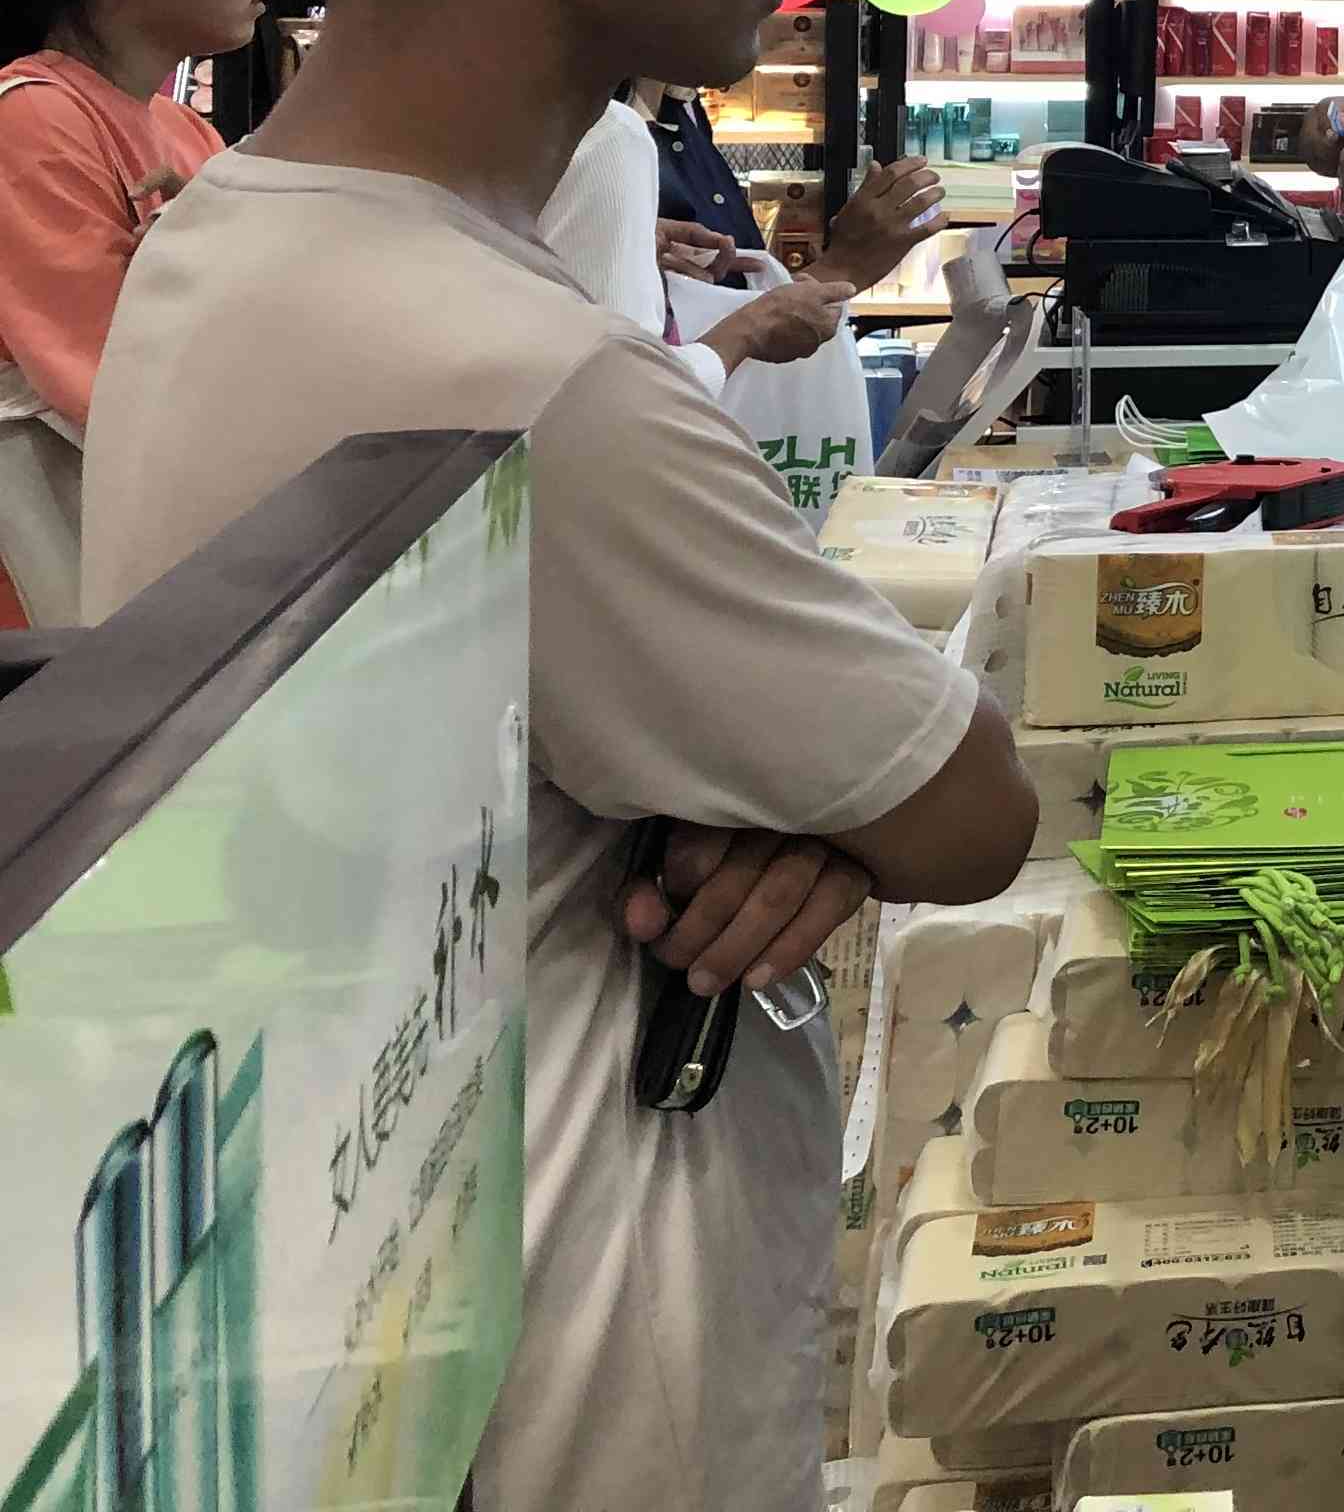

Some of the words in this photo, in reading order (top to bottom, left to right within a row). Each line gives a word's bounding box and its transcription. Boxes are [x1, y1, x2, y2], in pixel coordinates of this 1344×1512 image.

[1148, 672, 1181, 681] LIVING
[1104, 678, 1181, 698] Natural
[1292, 1106, 1343, 1122] 健康好生
